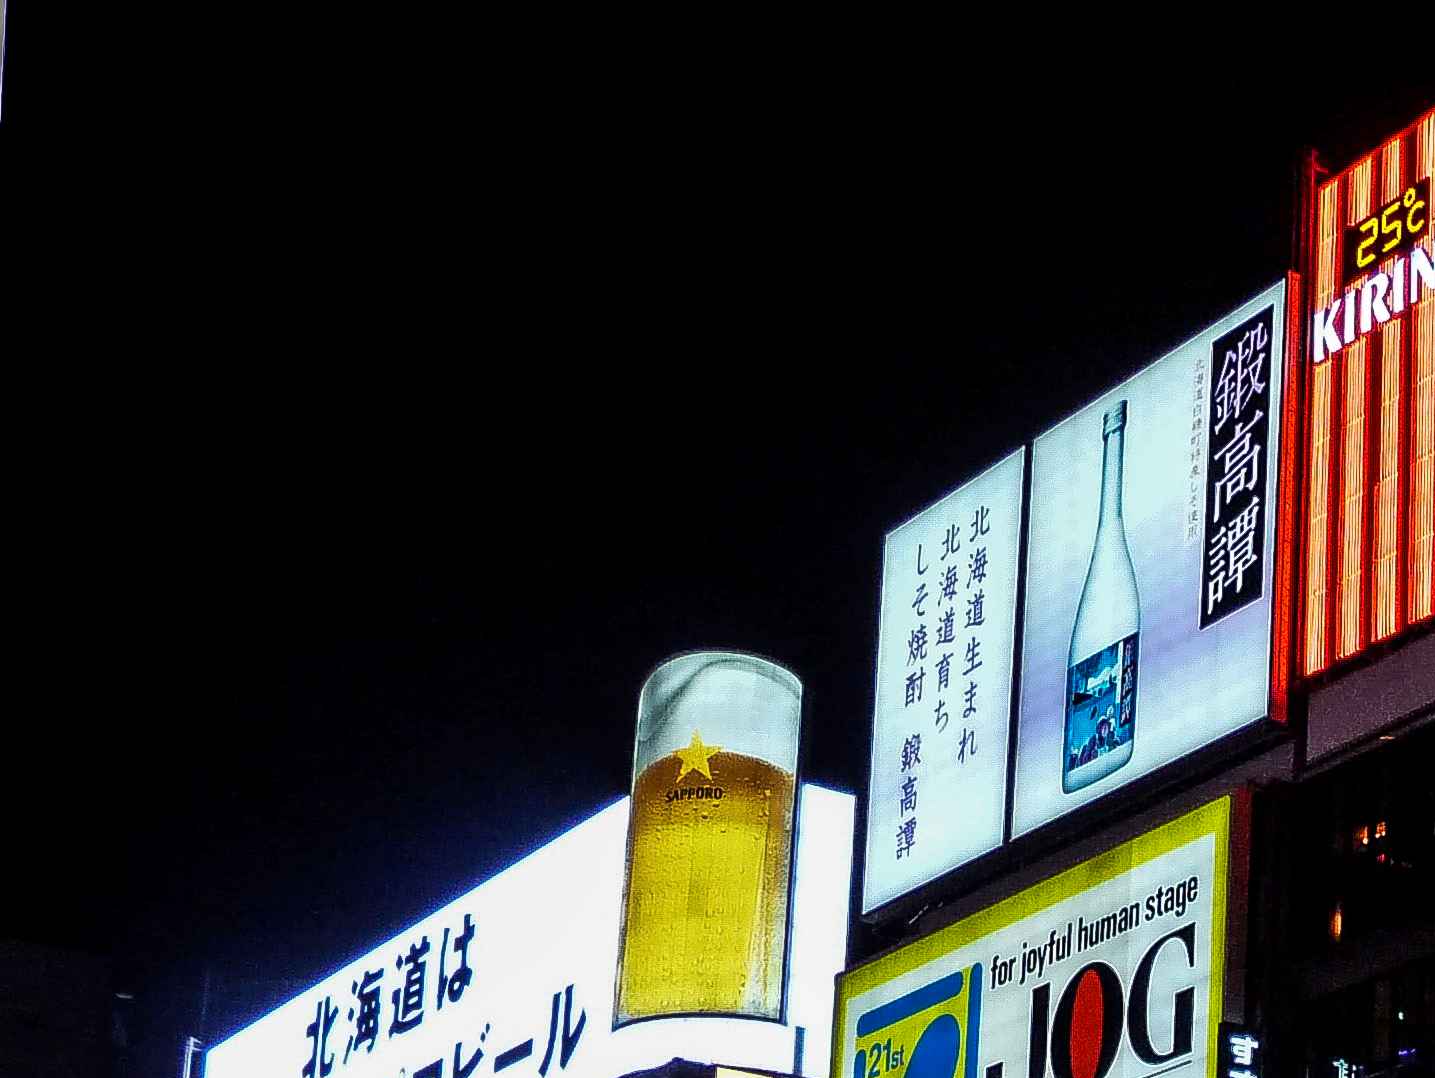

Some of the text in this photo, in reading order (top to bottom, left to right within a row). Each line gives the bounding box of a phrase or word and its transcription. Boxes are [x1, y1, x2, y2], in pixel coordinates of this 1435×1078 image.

[1207, 322, 1268, 616] 鍛高譚
[896, 543, 929, 861] しそ焼酎 鍛高譚
[934, 523, 961, 733] 北海道育ち
[958, 505, 990, 764] 北海道生まれ
[665, 786, 725, 802] SAPPORO
[991, 876, 1198, 988] for joyful human stage
